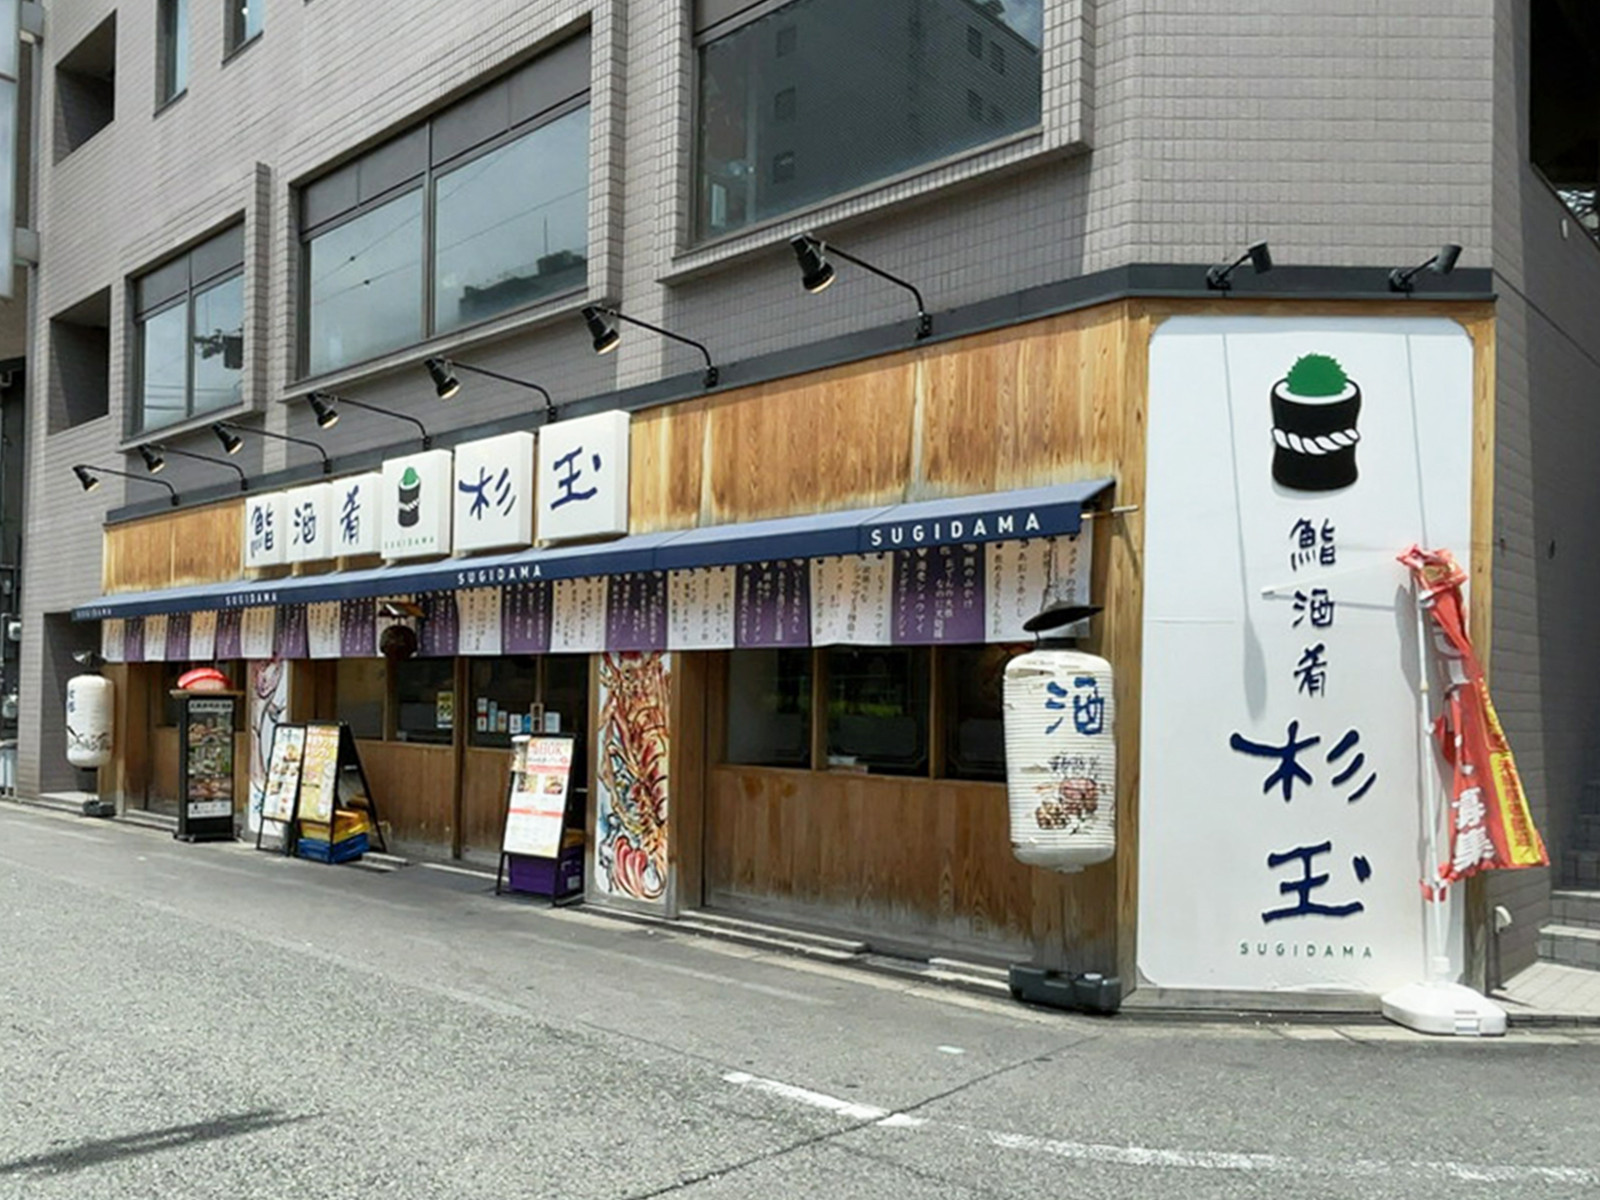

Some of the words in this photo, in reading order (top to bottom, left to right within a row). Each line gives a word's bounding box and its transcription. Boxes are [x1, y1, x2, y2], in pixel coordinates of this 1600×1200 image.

[458, 446, 602, 520] 杉玉
[384, 536, 434, 549] SUGIDAMA
[871, 512, 1041, 547] SUGIDAMA
[457, 565, 542, 585] SUGIDAMA
[225, 592, 278, 606] SUGIDAMA
[1045, 676, 1105, 736] 酒
[1229, 720, 1377, 924] 杉玉
[1239, 942, 1373, 958] SUGIDAMA
